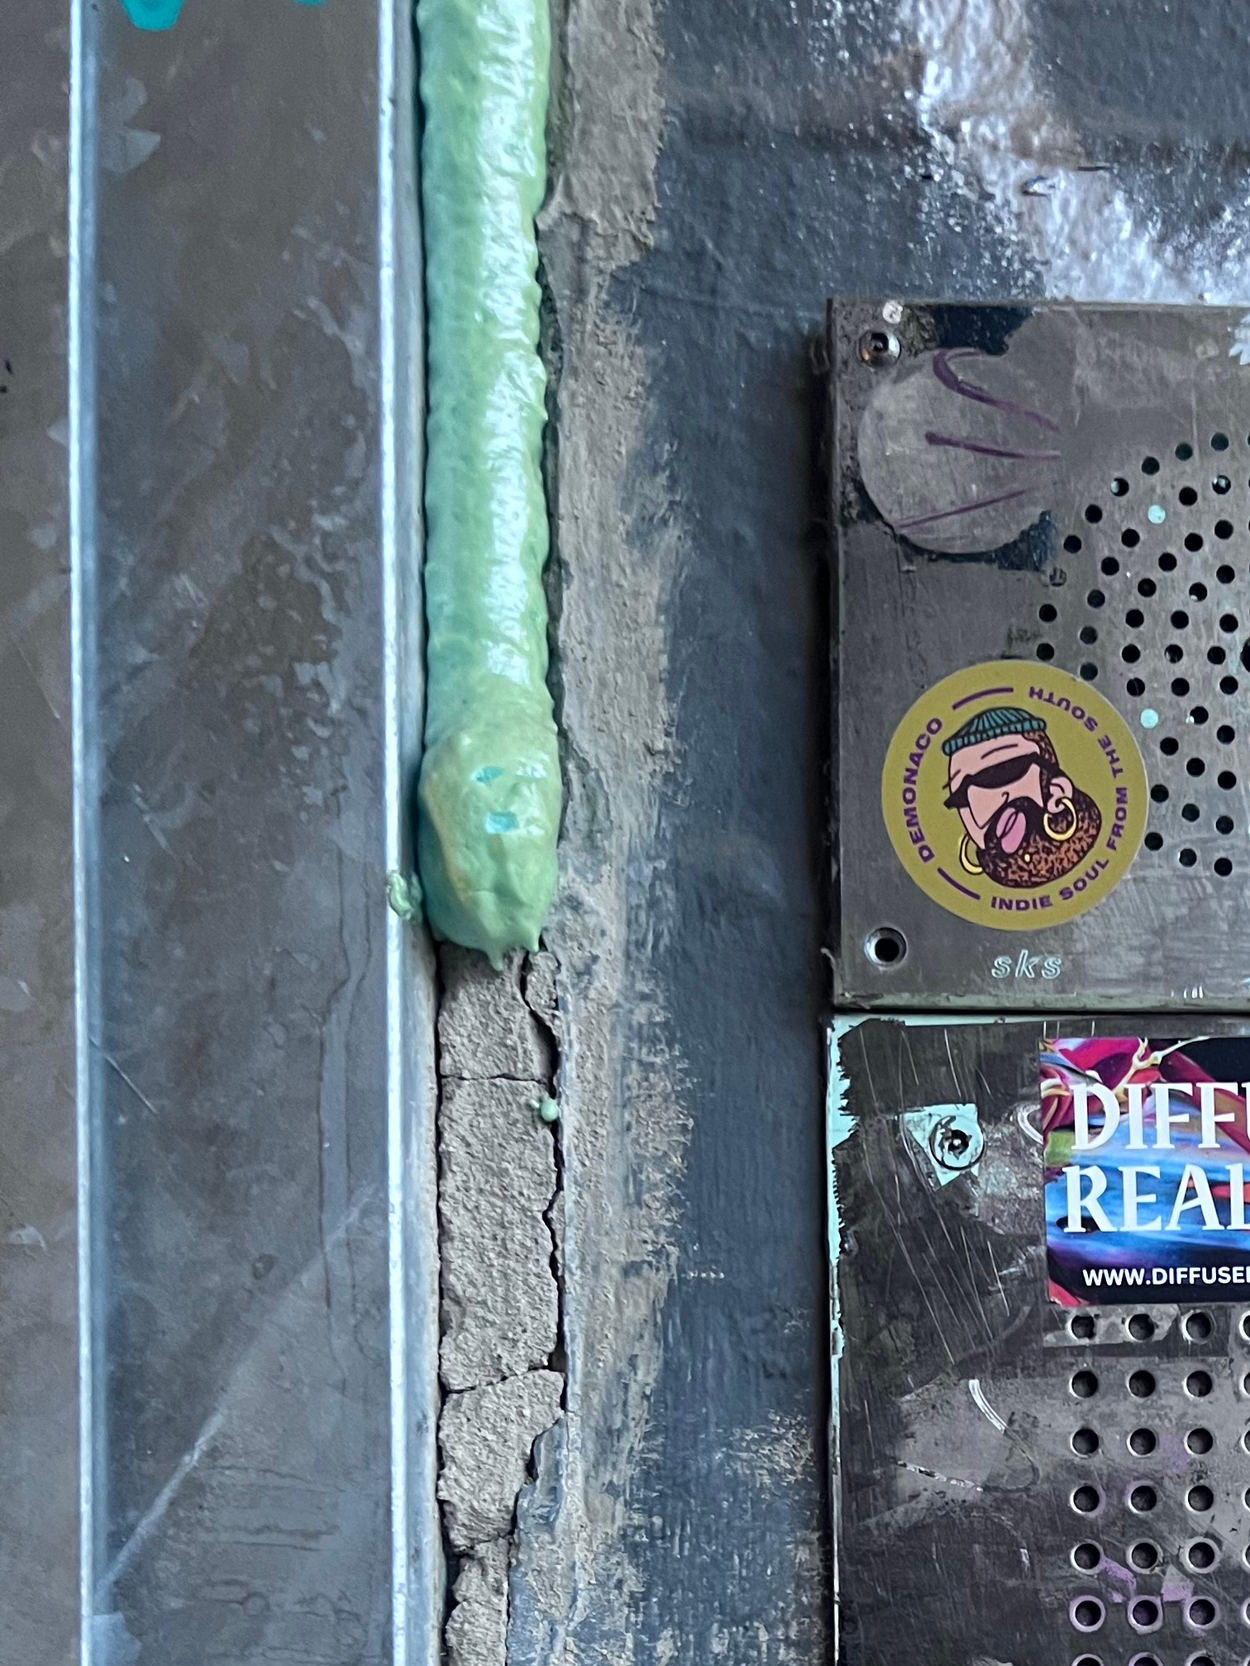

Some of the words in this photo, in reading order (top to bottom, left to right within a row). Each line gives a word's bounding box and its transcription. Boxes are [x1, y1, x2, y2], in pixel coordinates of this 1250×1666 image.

[1028, 685, 1099, 732] SOUTH
[1097, 735, 1125, 779] THE
[902, 717, 943, 863] DEMONACO
[1105, 786, 1129, 852] FROM
[1058, 858, 1110, 901] SOUL
[990, 895, 1054, 912] INDIE
[991, 950, 1062, 979] sks
